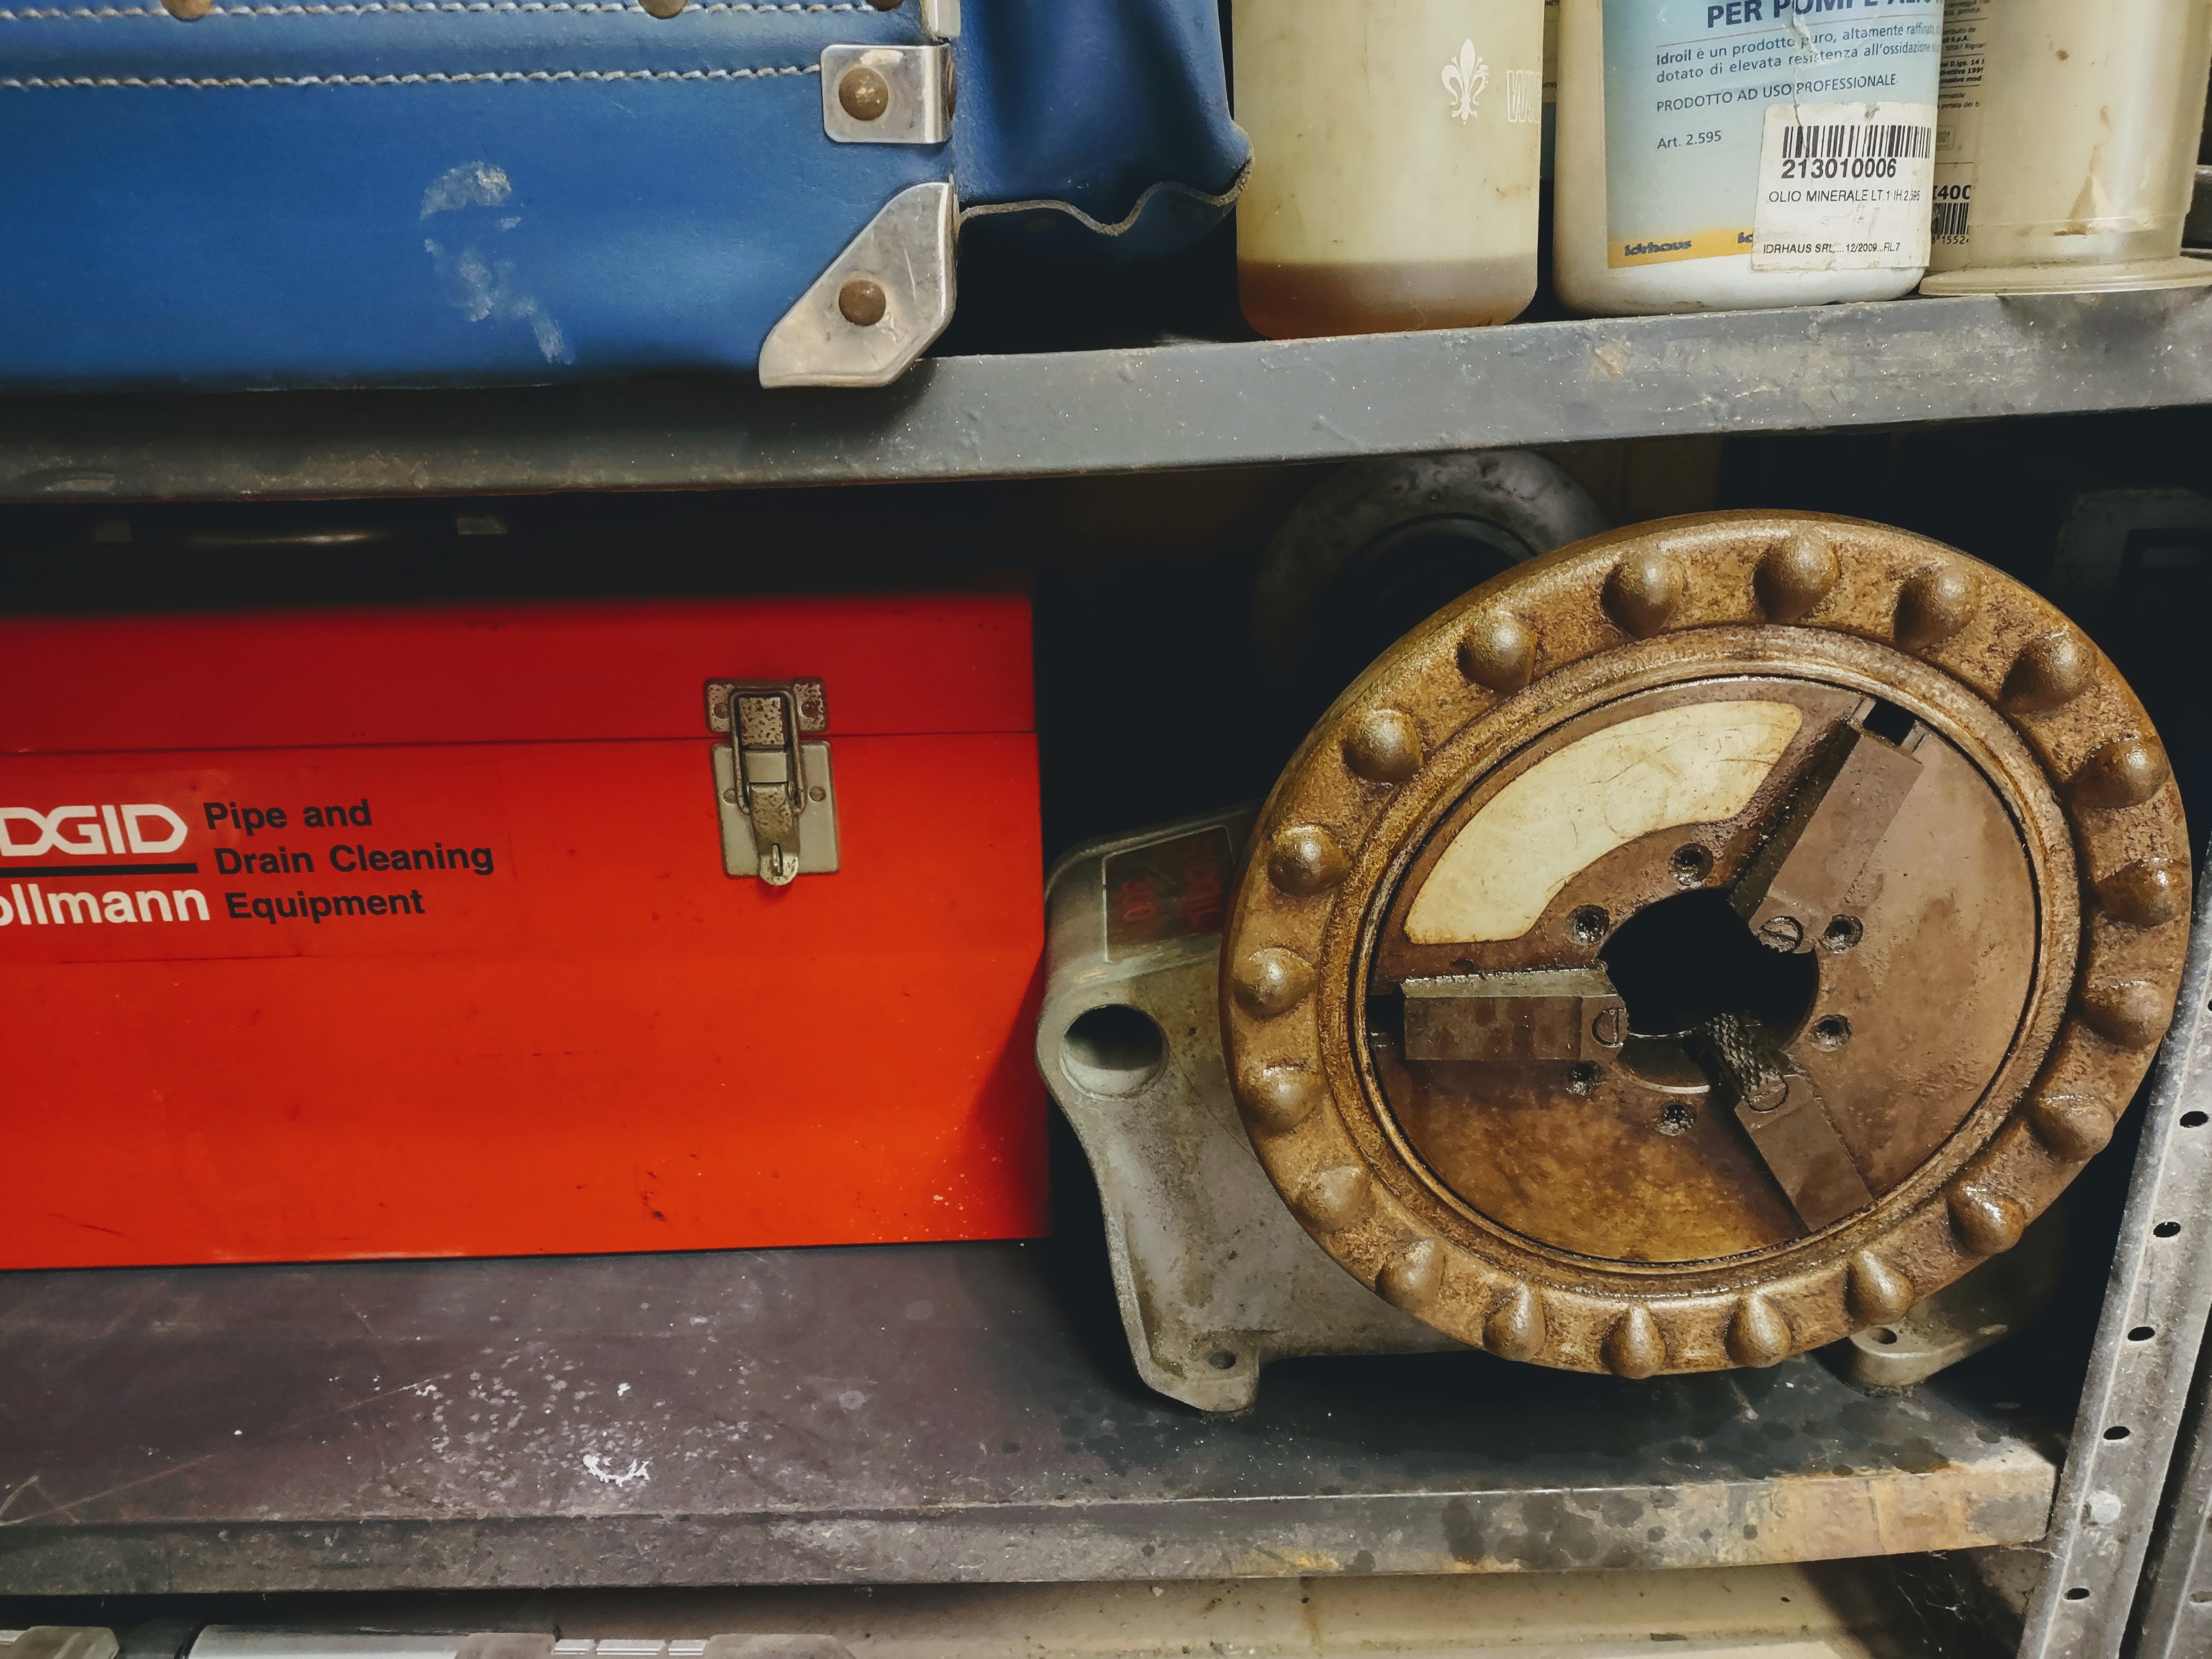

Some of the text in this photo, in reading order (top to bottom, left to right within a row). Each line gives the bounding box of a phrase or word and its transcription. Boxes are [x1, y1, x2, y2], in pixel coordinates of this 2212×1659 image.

[1707, 0, 1763, 28] PER
[1657, 49, 1691, 66] Idroil
[1709, 47, 1727, 58] un
[1732, 36, 1796, 58] prodotto
[1801, 33, 1837, 50] puro,
[1842, 25, 1905, 41] altamente
[1657, 67, 1704, 84] dotato
[1709, 62, 1723, 76] di
[1729, 56, 1782, 74] elevata
[1788, 48, 1858, 66] resistenza
[1864, 40, 1931, 57] all'ossidazione
[1657, 91, 1733, 112] PRODOTTO
[1737, 88, 1758, 102] AD
[1763, 84, 1792, 98] USO
[1657, 130, 1722, 150] Art. 2.595
[1781, 158, 1897, 179] 213010006
[1769, 190, 1802, 203] OLIO
[1806, 189, 1869, 202] MINERALE
[1763, 243, 1812, 254] IDRHAUS
[203, 799, 372, 836] Pipe and
[214, 842, 494, 876] Drain Cleaning
[225, 889, 426, 925] Equipment
